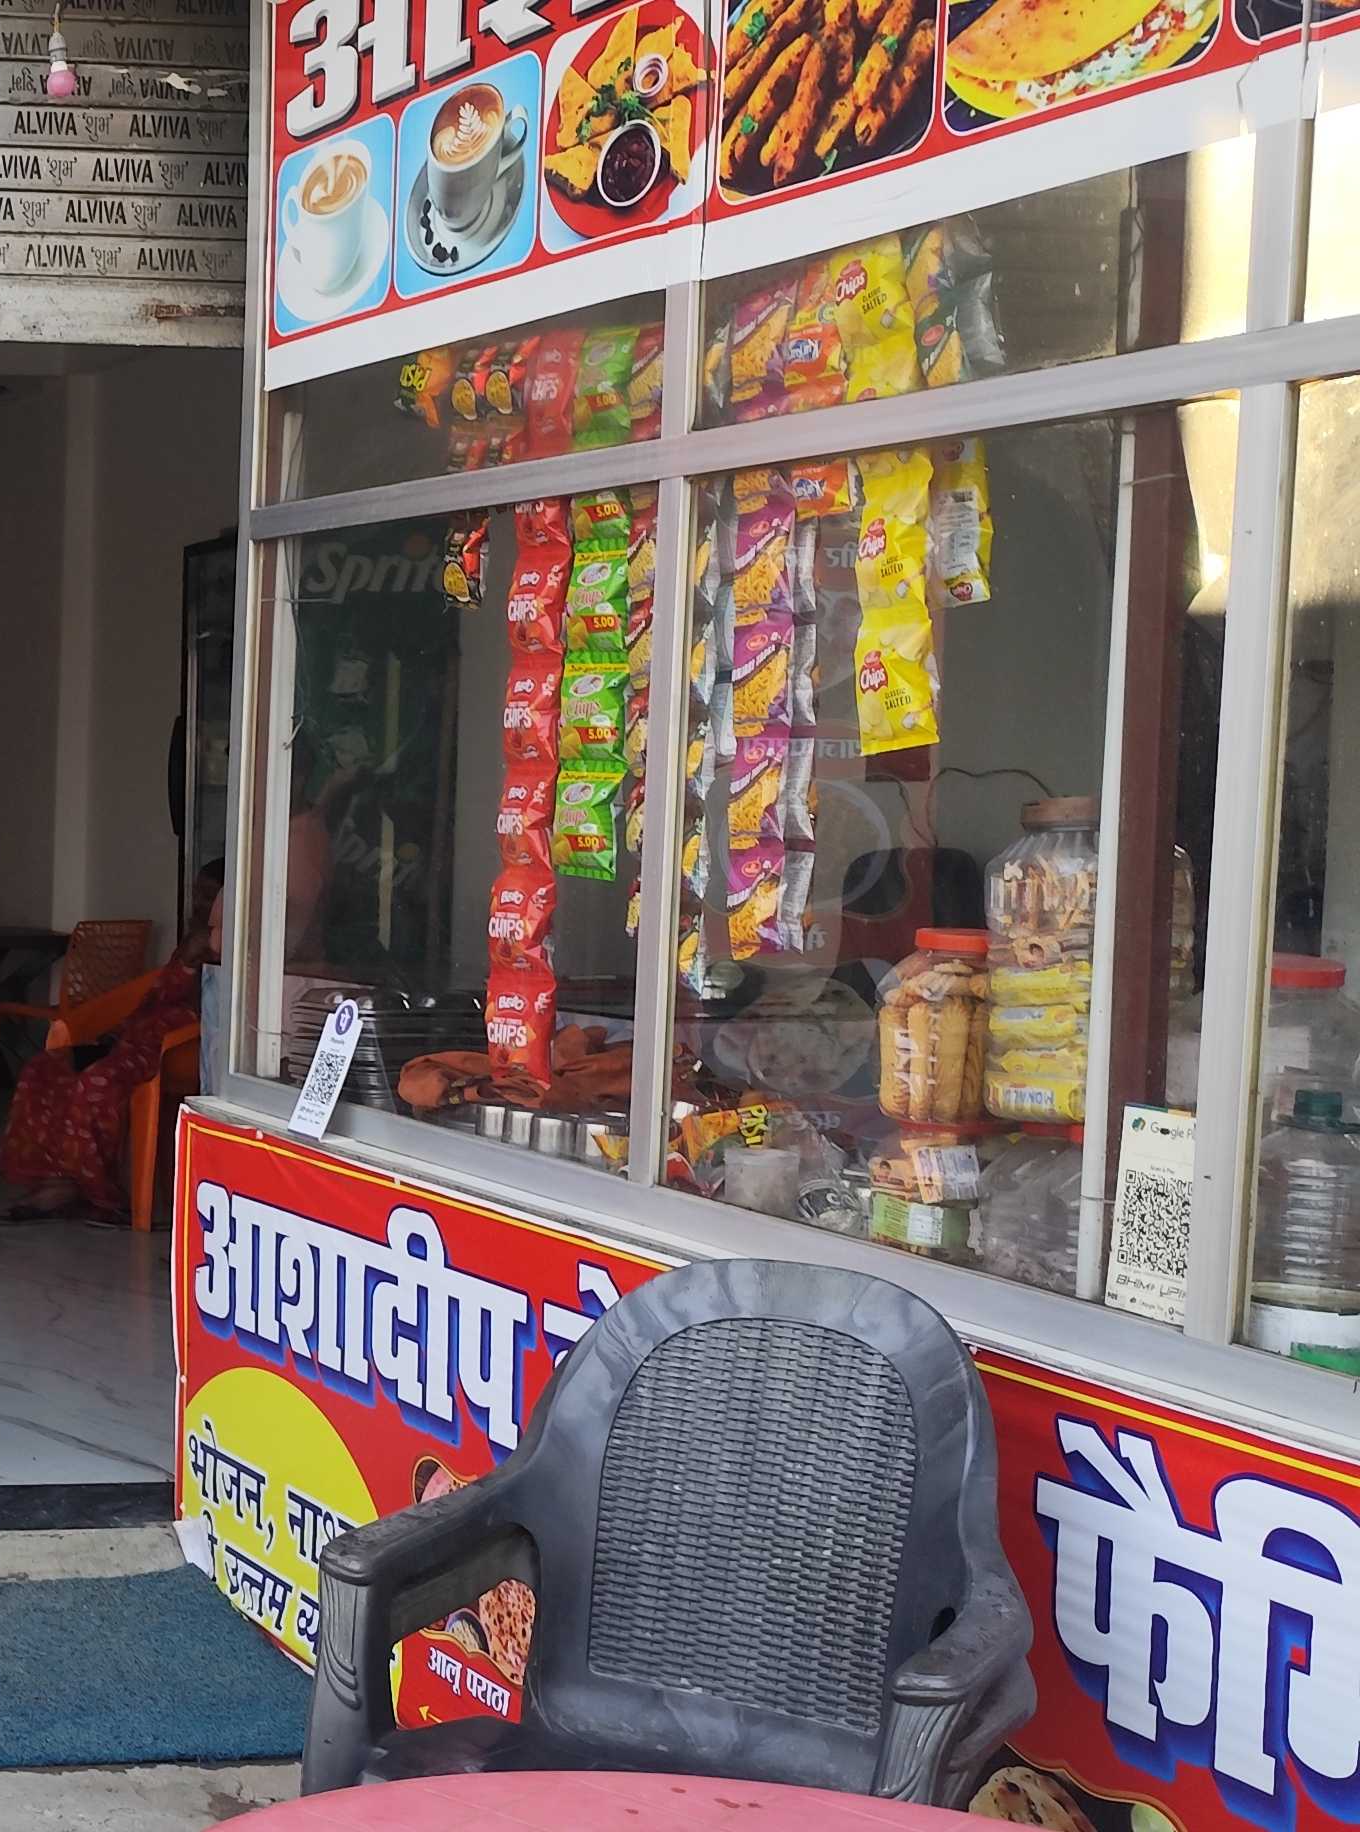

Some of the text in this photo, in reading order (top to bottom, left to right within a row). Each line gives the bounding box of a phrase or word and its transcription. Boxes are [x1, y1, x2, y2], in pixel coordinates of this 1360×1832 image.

[14, 111, 76, 137] ALVIVA
[129, 114, 191, 139] ALVIVA
[92, 158, 153, 184] ALVIVA
[65, 199, 126, 225] ALVIVA
[26, 244, 86, 268] ALVIVA
[137, 248, 197, 272] ALVIVA
[304, 542, 443, 603] Sprit
[507, 600, 537, 621] CHIPS
[593, 616, 615, 629] 5.00
[504, 706, 532, 729] CHIPS
[587, 727, 612, 740] 5.00
[496, 812, 523, 835] CHIPS
[488, 917, 525, 939] CHIPS
[487, 1021, 528, 1048] CHIPS
[194, 1180, 532, 1448] आशादीप
[188, 1418, 275, 1550] भोजन,
[427, 1645, 512, 1717] आलू पराठा
